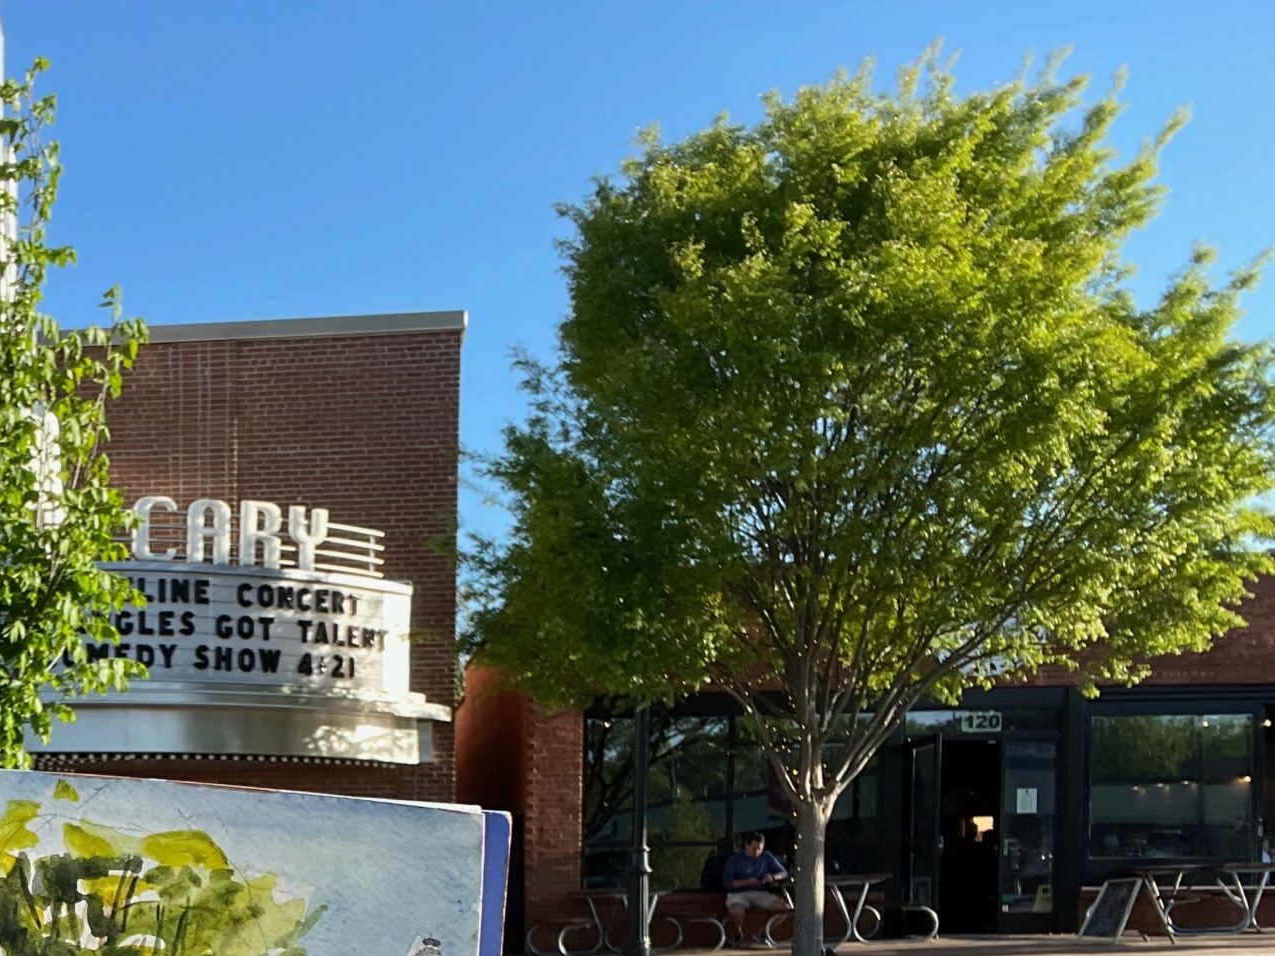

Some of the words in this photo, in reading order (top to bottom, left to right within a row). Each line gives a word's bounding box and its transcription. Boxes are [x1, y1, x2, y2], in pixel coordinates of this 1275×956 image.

[131, 496, 329, 572] CARY
[237, 583, 360, 616] CONCERT
[215, 614, 274, 641] GOT
[297, 620, 389, 652] TALENT
[193, 644, 281, 673] SHOW
[964, 713, 1001, 729] 120
